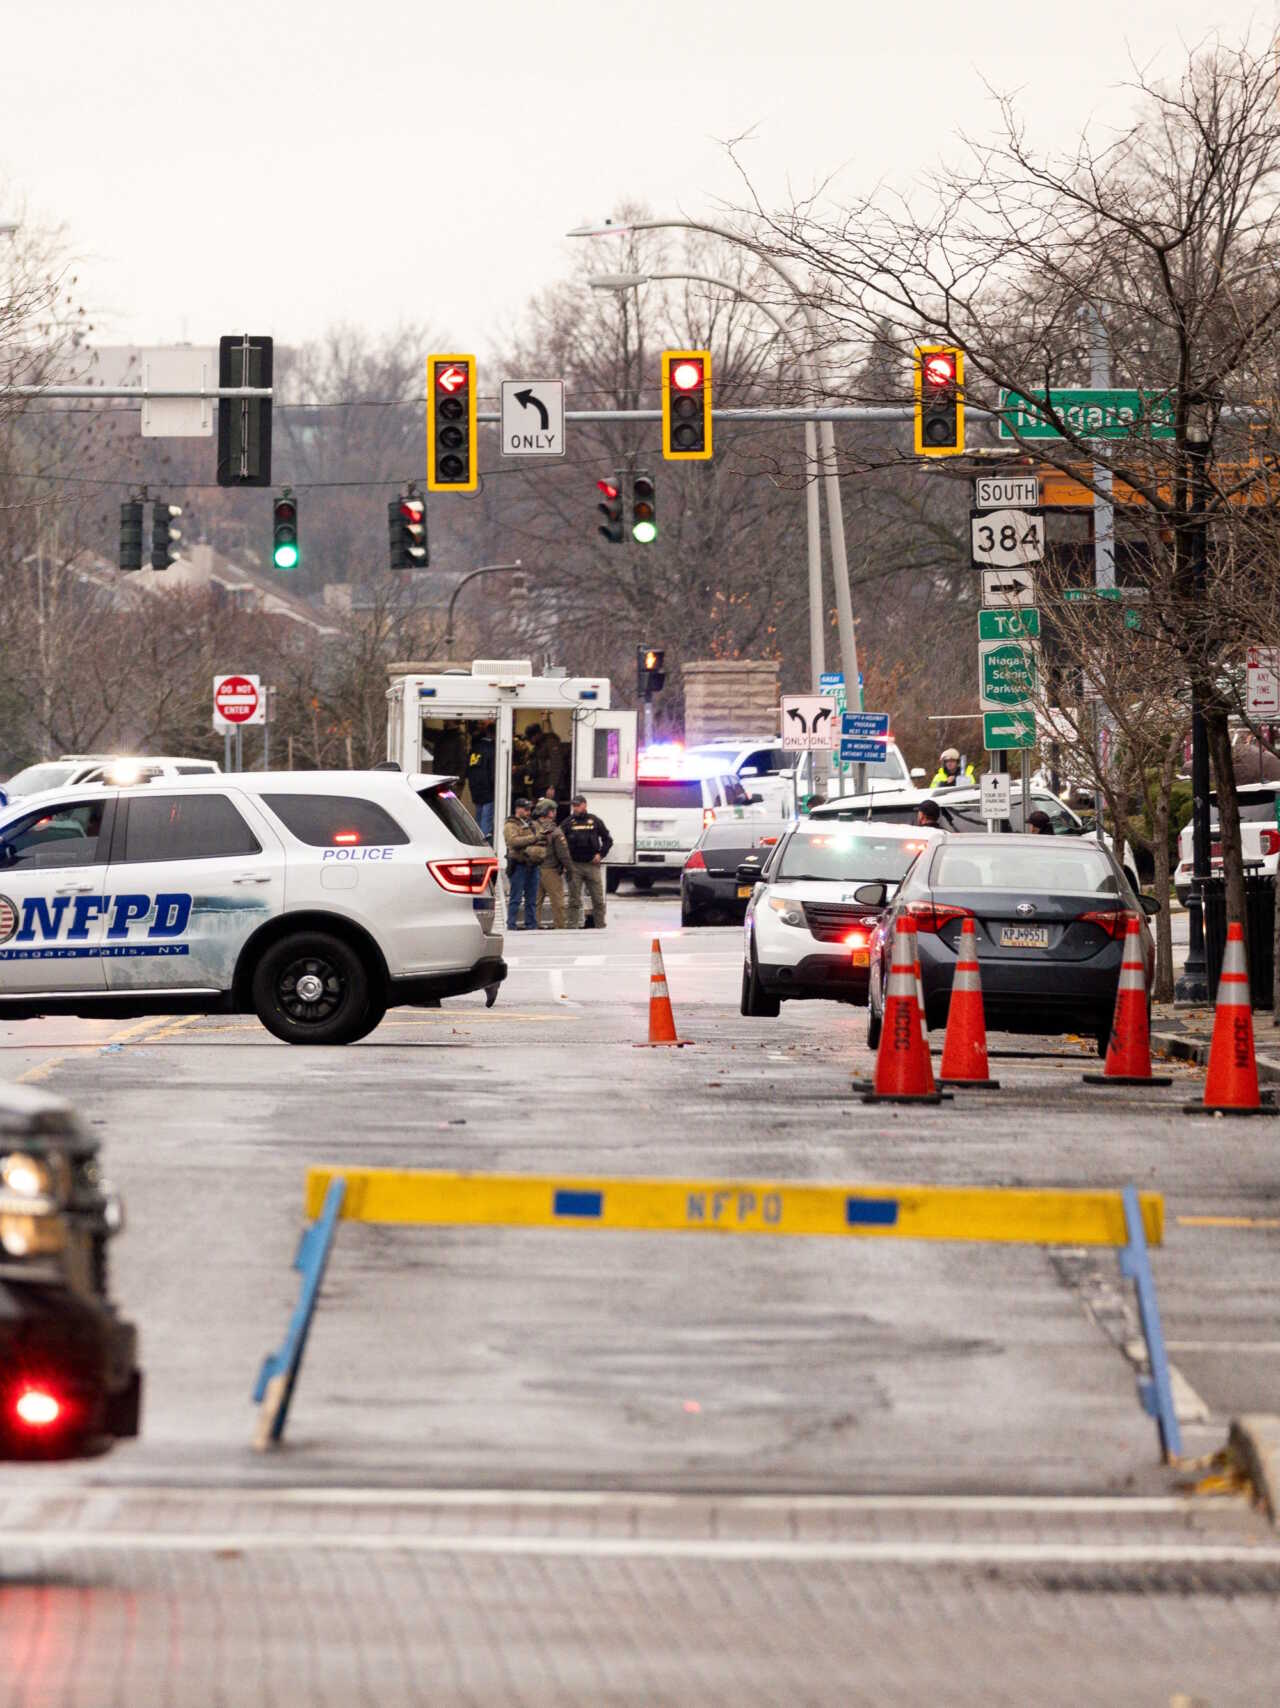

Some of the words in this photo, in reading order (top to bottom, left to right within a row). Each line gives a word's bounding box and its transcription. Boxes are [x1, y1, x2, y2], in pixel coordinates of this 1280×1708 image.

[511, 435, 555, 448] ONLY
[981, 484, 1035, 501] SOUTH
[978, 524, 1040, 552] 384
[994, 616, 1024, 633] TO
[221, 685, 232, 693] DO
[236, 685, 251, 693] NOT
[1256, 686, 1271, 695] TIME
[224, 706, 249, 714] ENTER
[785, 737, 807, 745] ONLY
[322, 848, 395, 861] POLICE
[15, 893, 193, 942] NFPD
[158, 945, 184, 954] NY
